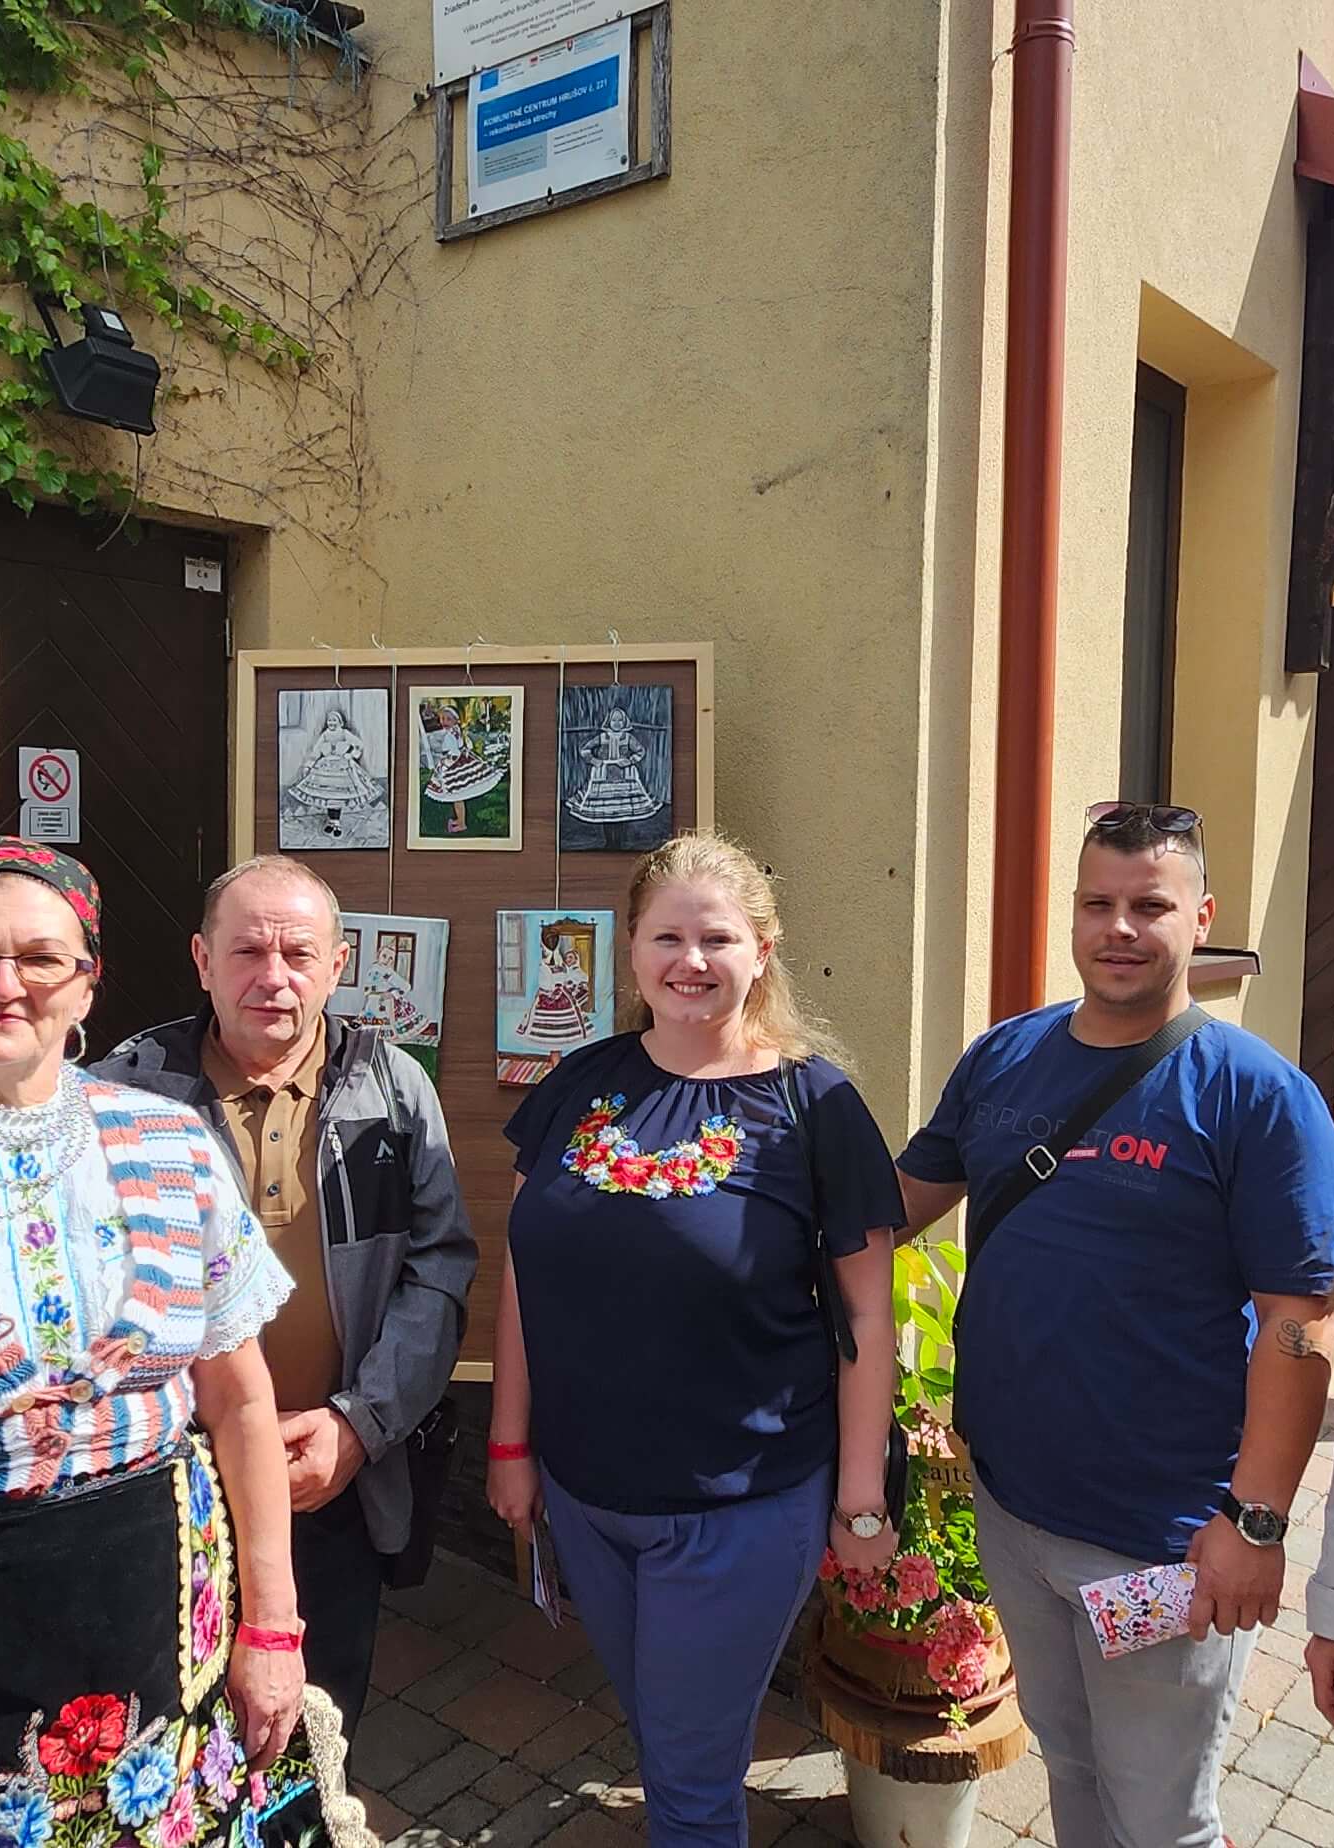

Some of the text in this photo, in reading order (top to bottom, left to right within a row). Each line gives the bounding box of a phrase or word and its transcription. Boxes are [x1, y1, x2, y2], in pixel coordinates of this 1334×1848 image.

[523, 94, 558, 114] CENTRUM
[558, 85, 588, 105] HRUŠOV
[532, 109, 558, 124] strechy
